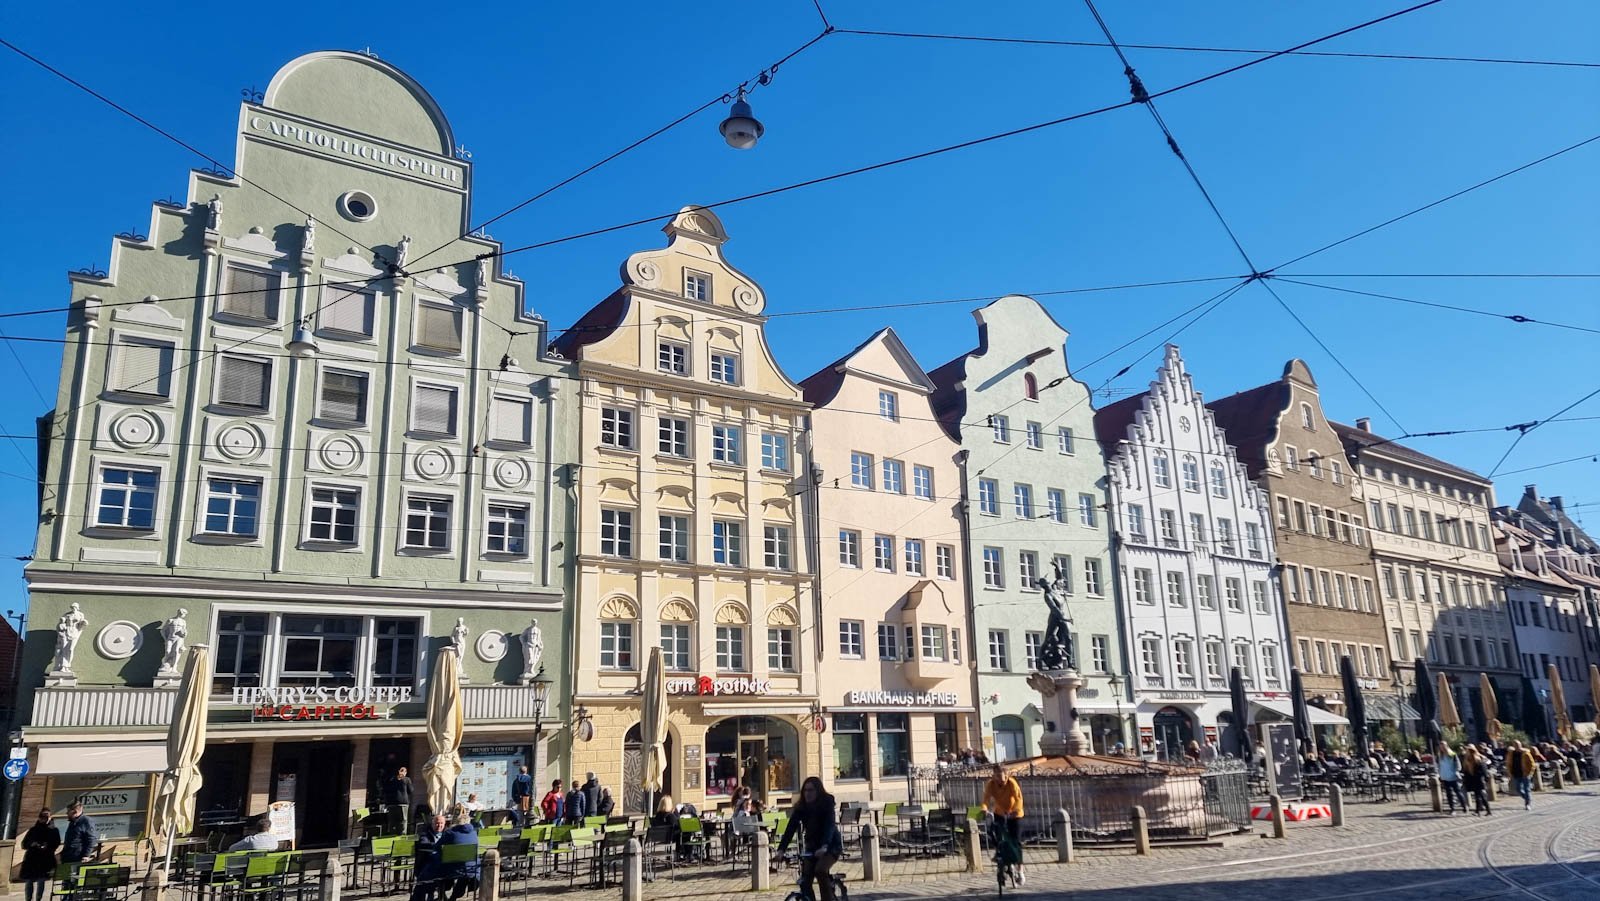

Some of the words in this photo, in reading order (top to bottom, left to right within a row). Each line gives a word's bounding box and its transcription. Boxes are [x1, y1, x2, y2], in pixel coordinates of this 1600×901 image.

[698, 675, 772, 697] Apotheke
[232, 686, 328, 705] HENRY'S
[334, 685, 412, 704] COFFEE
[851, 690, 914, 705] BANKHAUS
[916, 691, 959, 705] HAFNER
[279, 703, 380, 720] CAPITOL
[74, 793, 128, 806] HENRY'S
